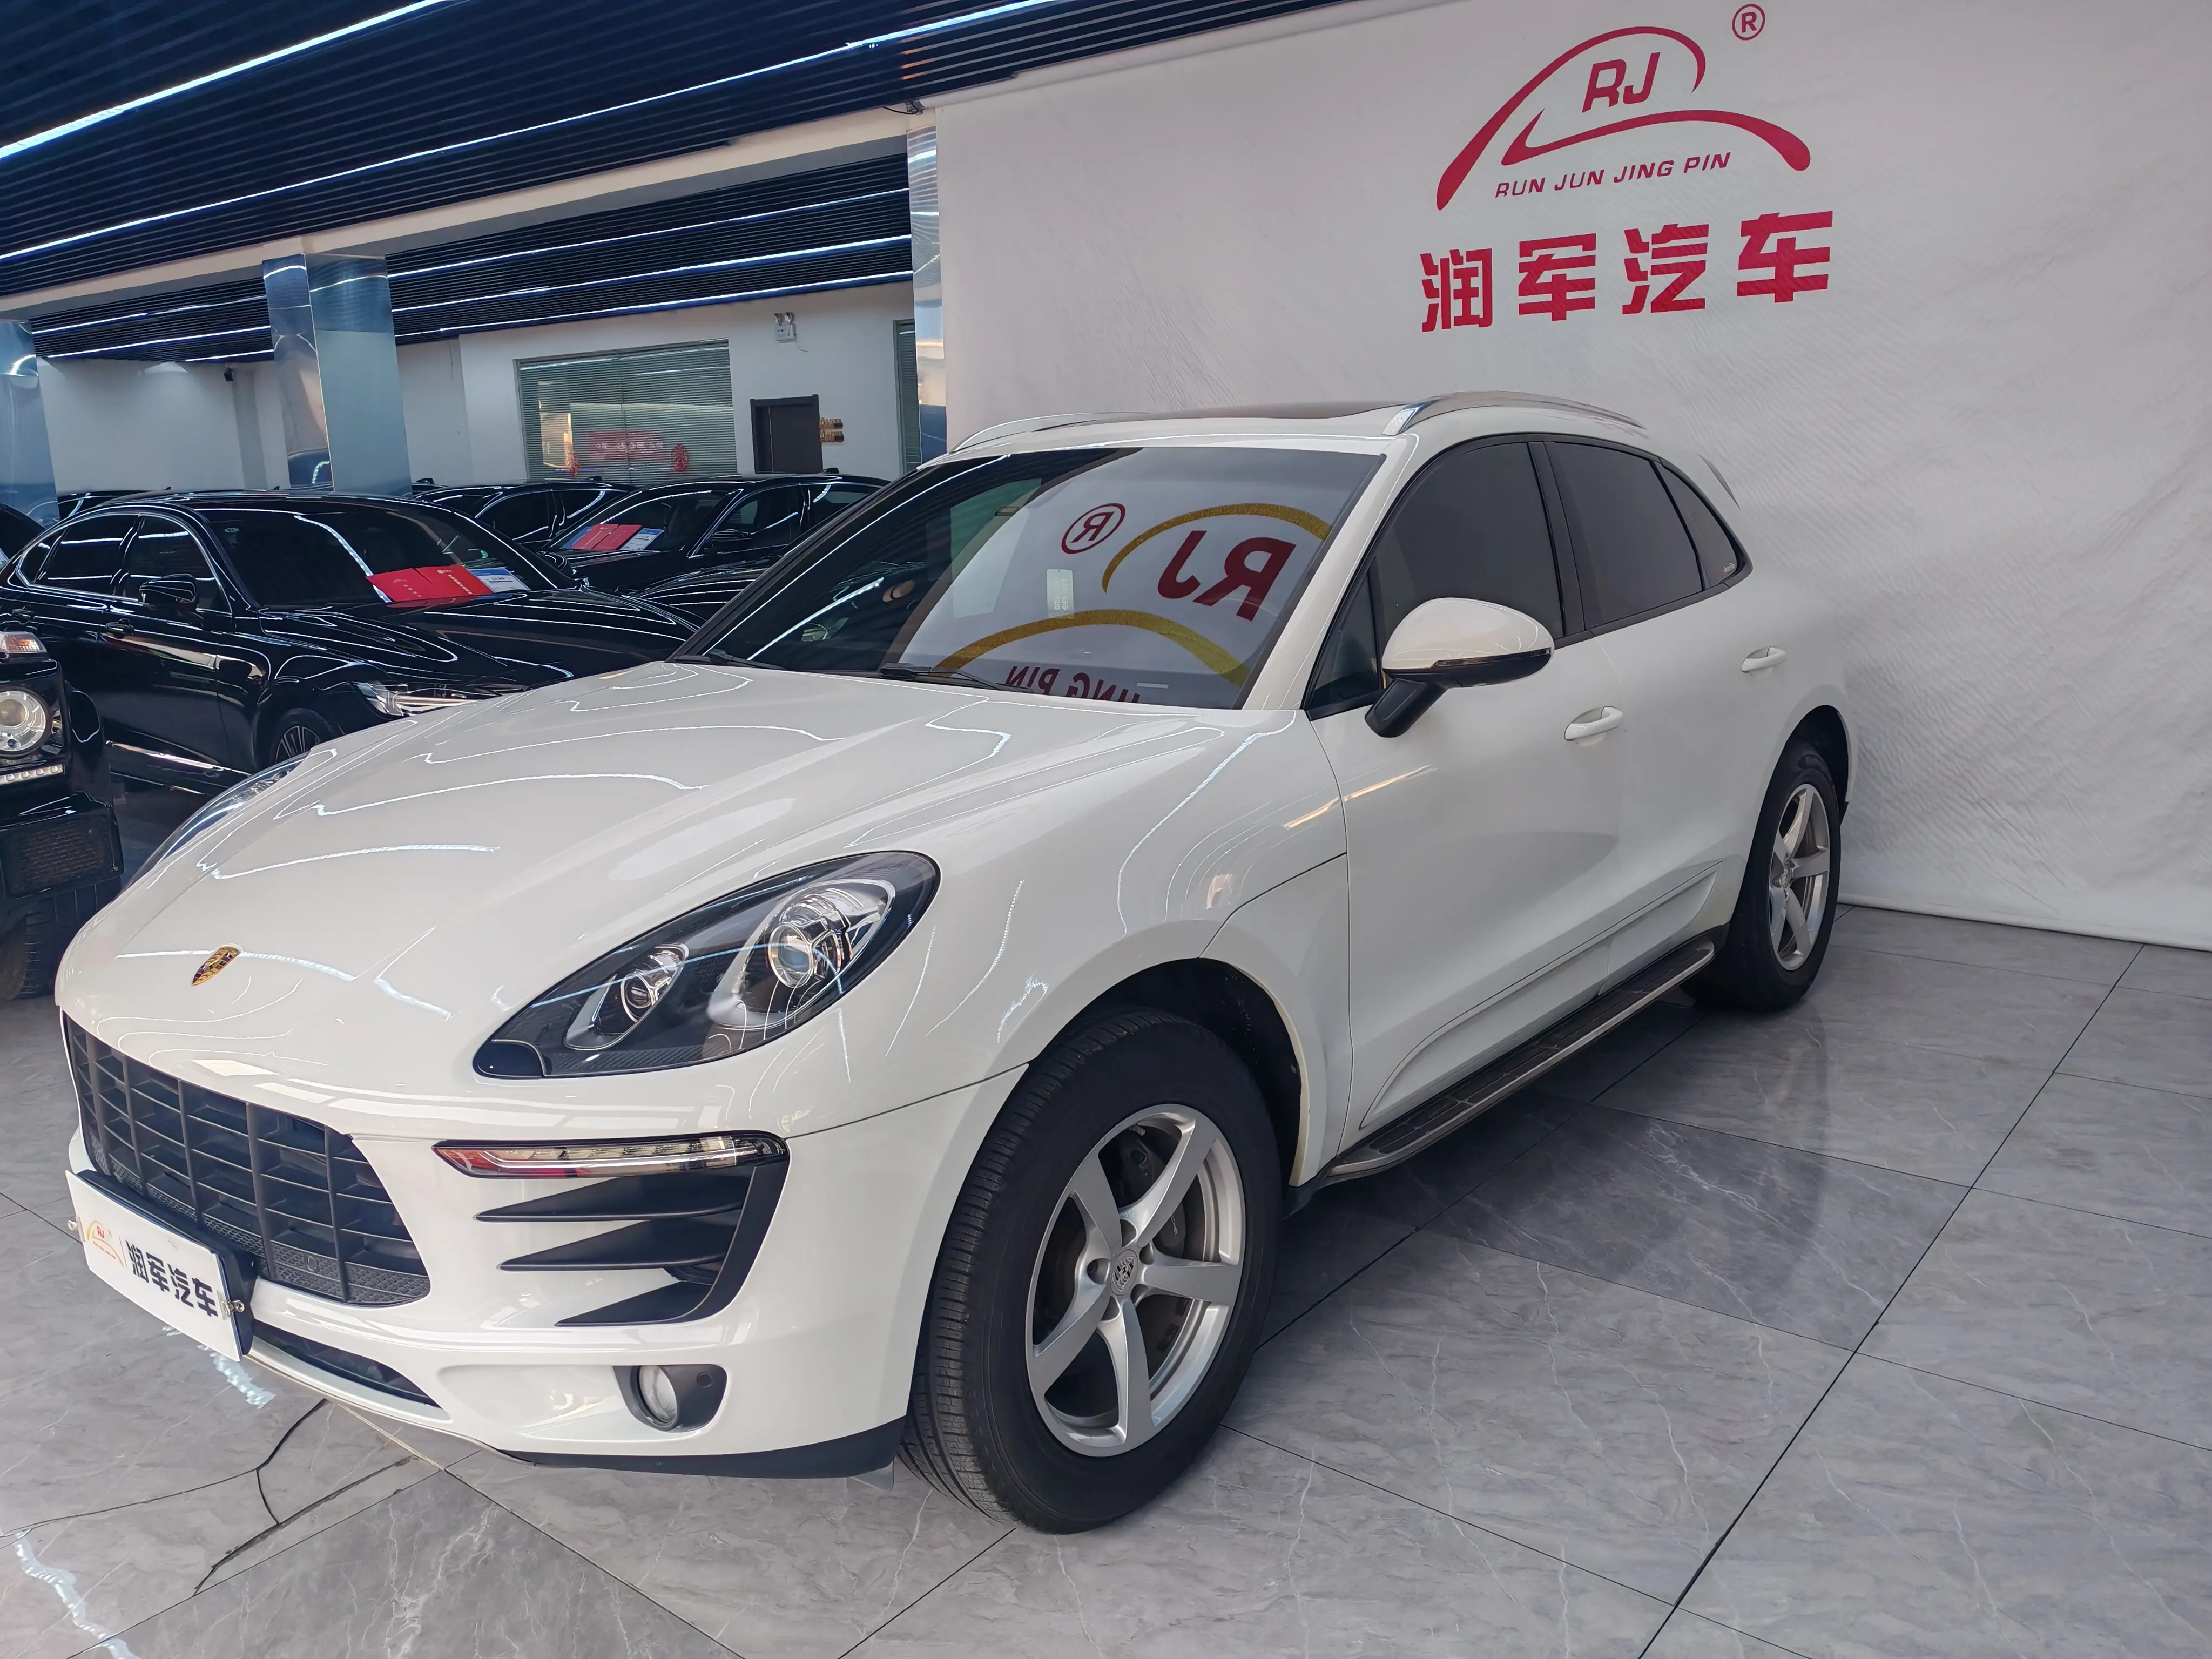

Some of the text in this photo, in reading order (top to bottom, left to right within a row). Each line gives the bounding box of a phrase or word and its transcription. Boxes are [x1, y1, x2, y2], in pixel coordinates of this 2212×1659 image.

[1582, 51, 1661, 113] RJ
[1495, 152, 1731, 198] RUN JUN JING PIN
[1420, 211, 1833, 333] 润军汽车
[125, 1240, 219, 1318] 润军汽车
